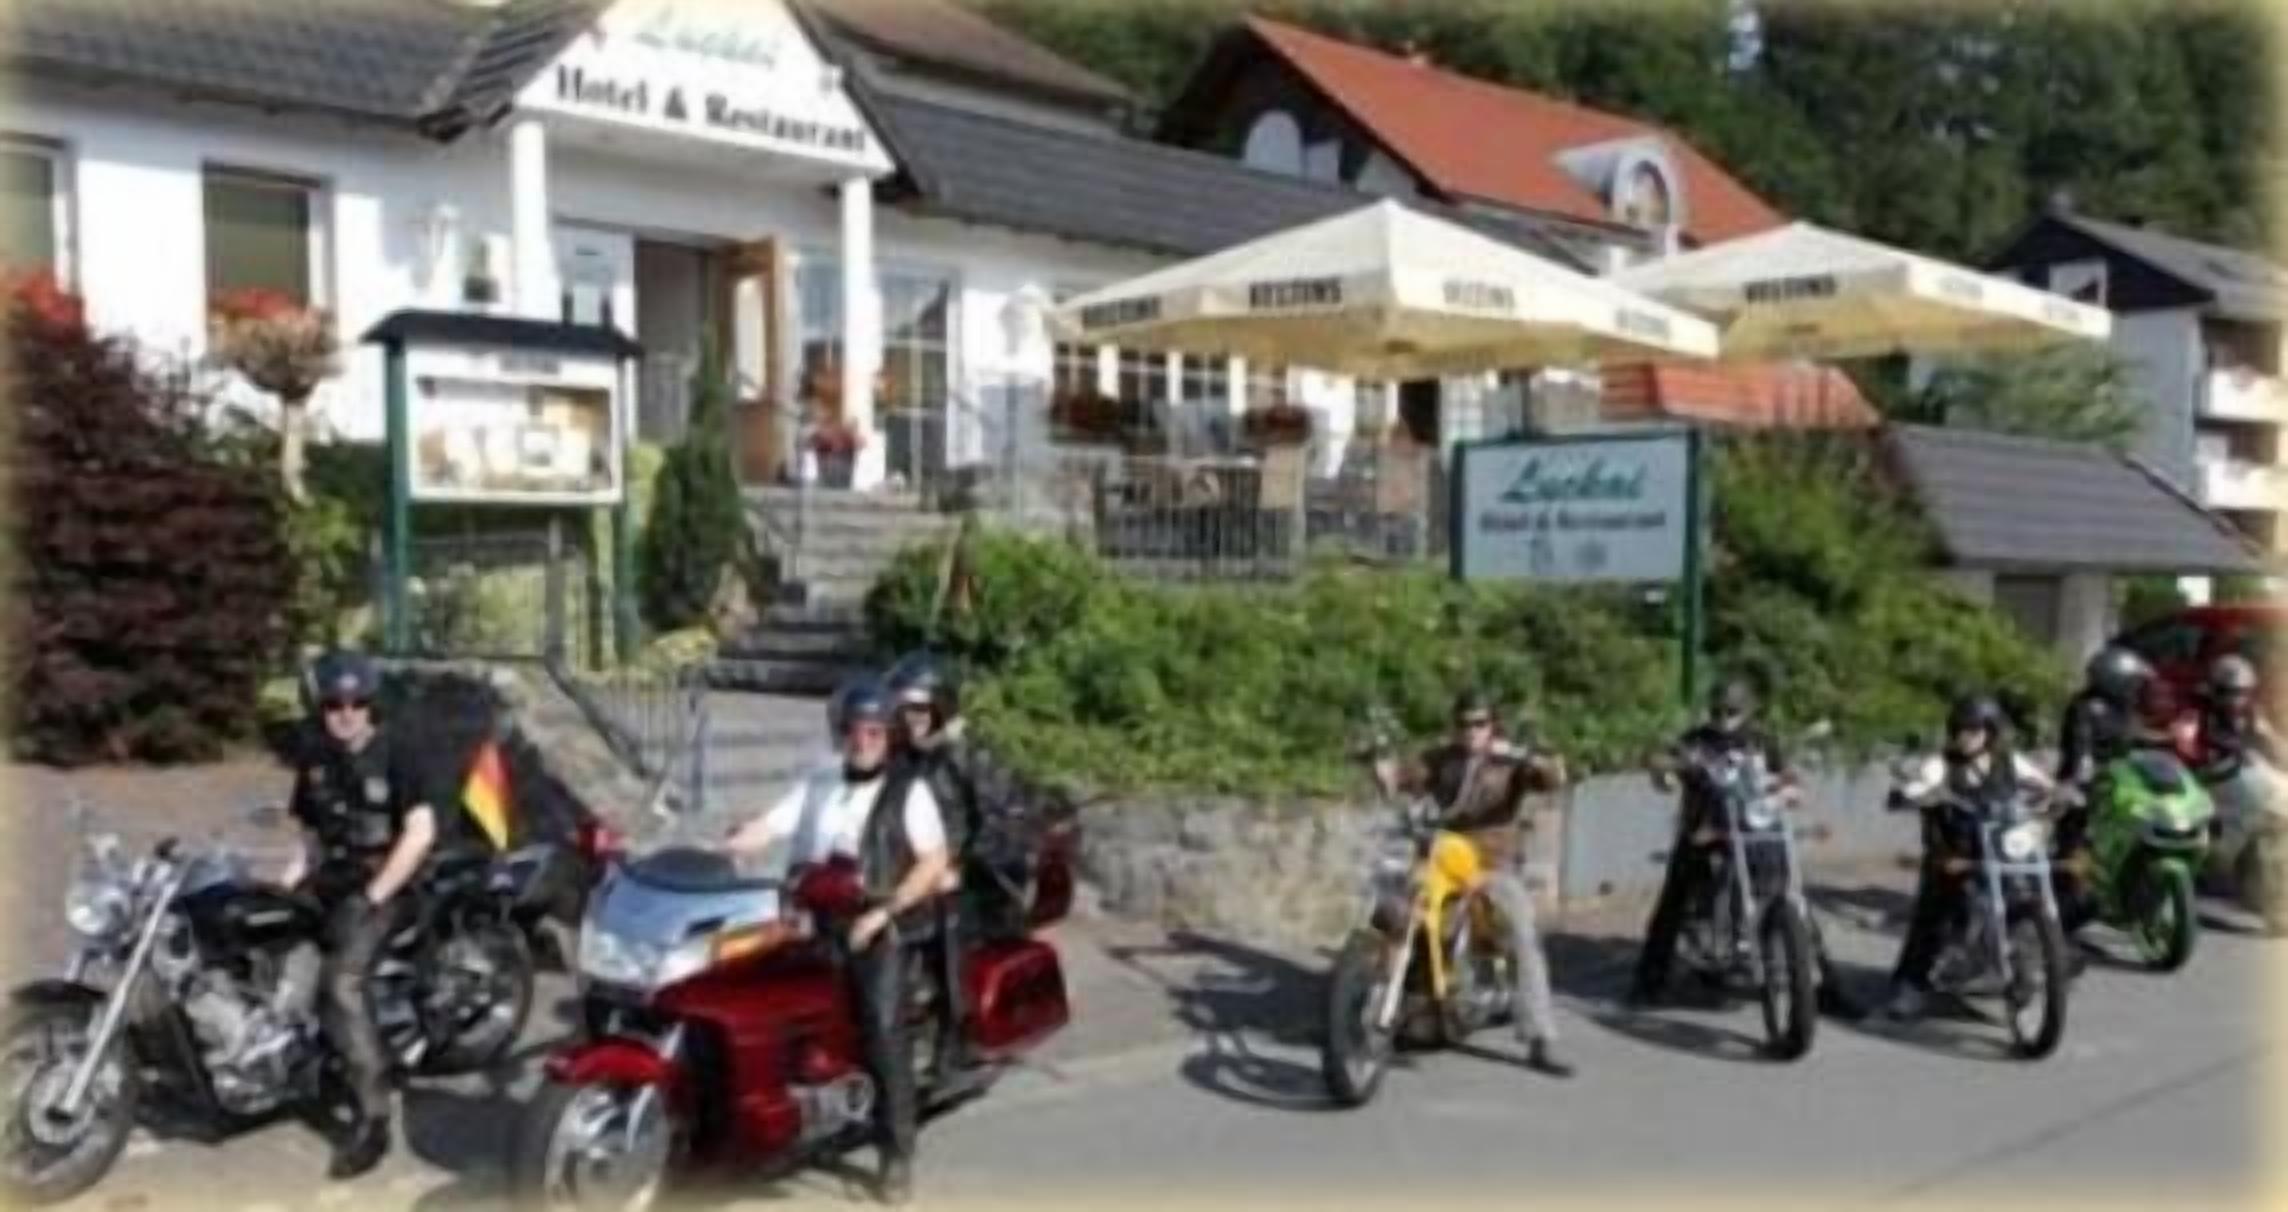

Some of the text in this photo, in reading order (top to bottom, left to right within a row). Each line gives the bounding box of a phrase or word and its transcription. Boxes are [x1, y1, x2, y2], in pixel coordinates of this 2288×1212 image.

[556, 63, 867, 153] Hotel & Restaurant
